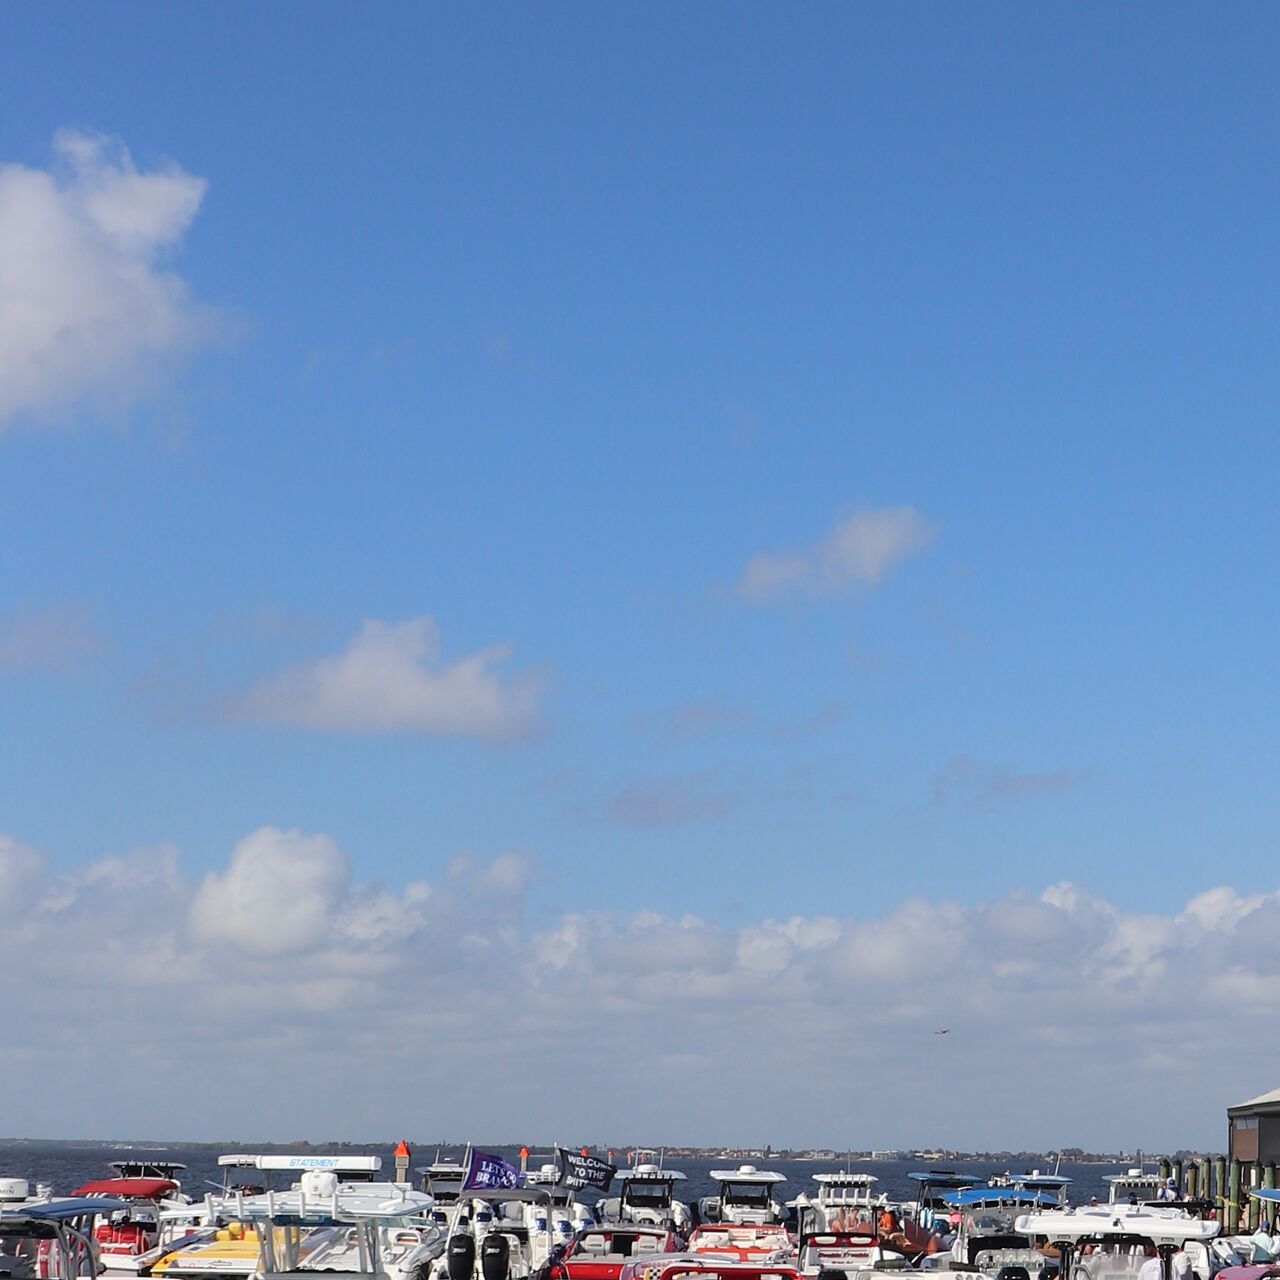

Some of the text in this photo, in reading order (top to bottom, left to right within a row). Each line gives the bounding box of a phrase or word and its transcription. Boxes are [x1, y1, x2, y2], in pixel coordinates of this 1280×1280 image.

[289, 1158, 340, 1167] STATEMENT
[574, 1166, 606, 1179] TO THE
